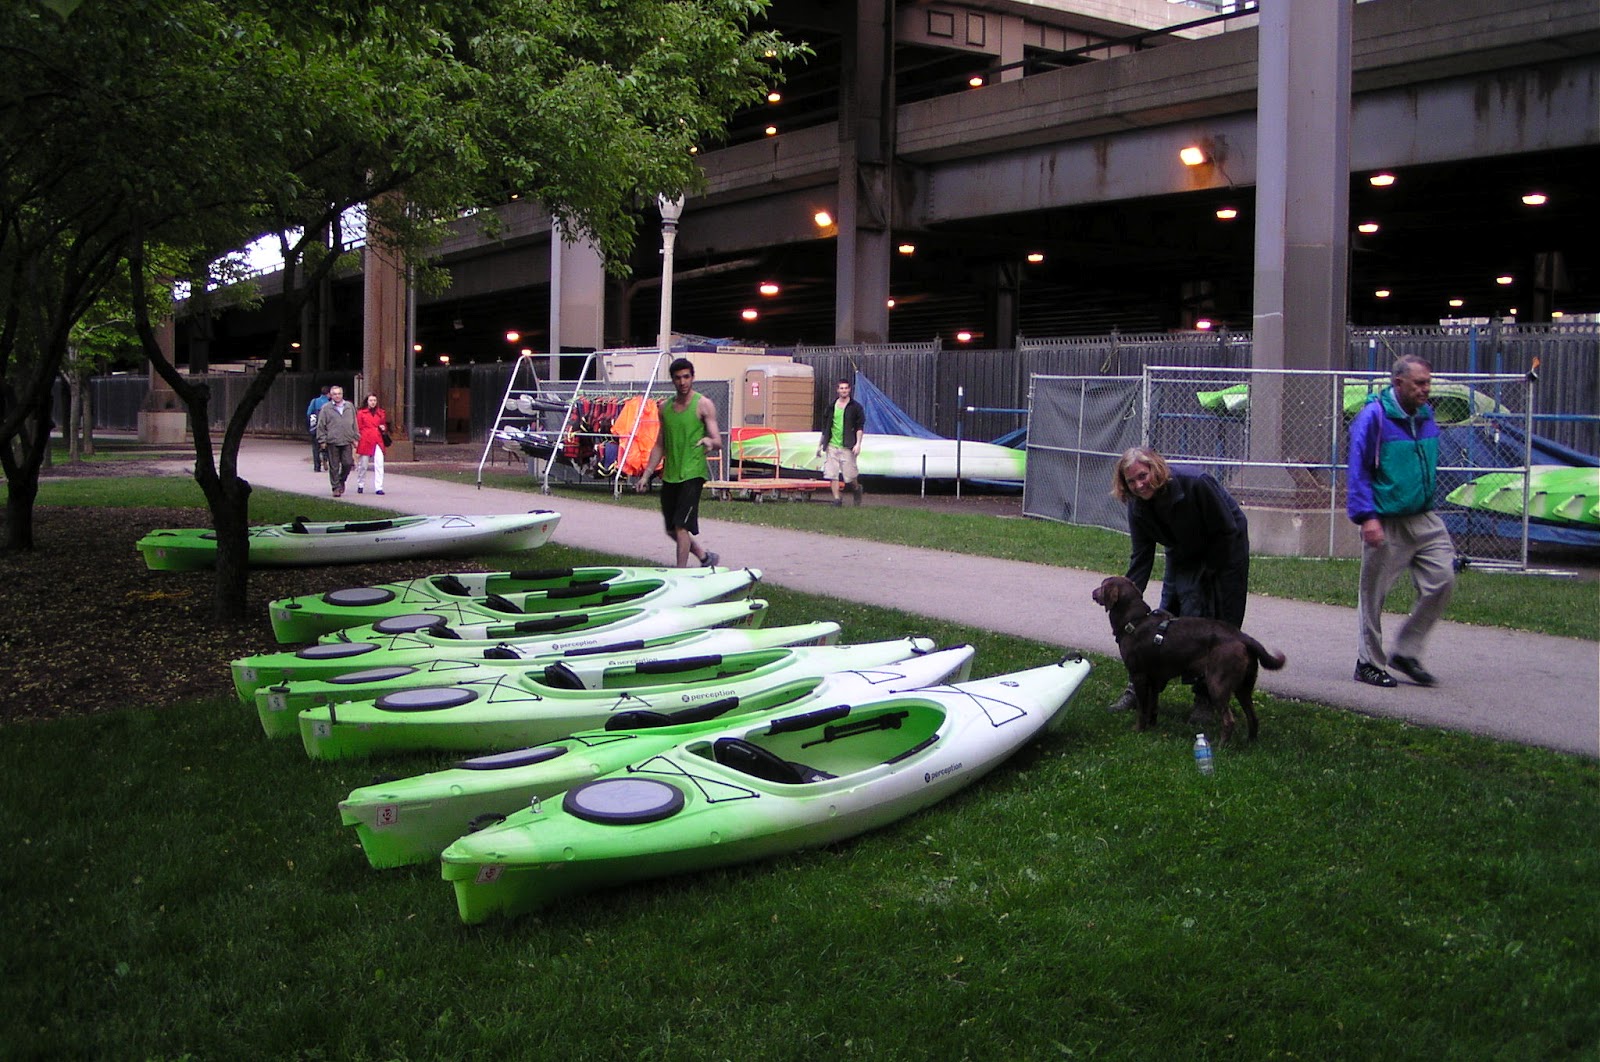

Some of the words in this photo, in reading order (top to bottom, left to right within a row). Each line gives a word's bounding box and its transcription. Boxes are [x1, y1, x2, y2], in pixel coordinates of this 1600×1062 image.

[560, 640, 598, 649] perception
[691, 689, 736, 701] perception
[931, 762, 963, 781] perception
